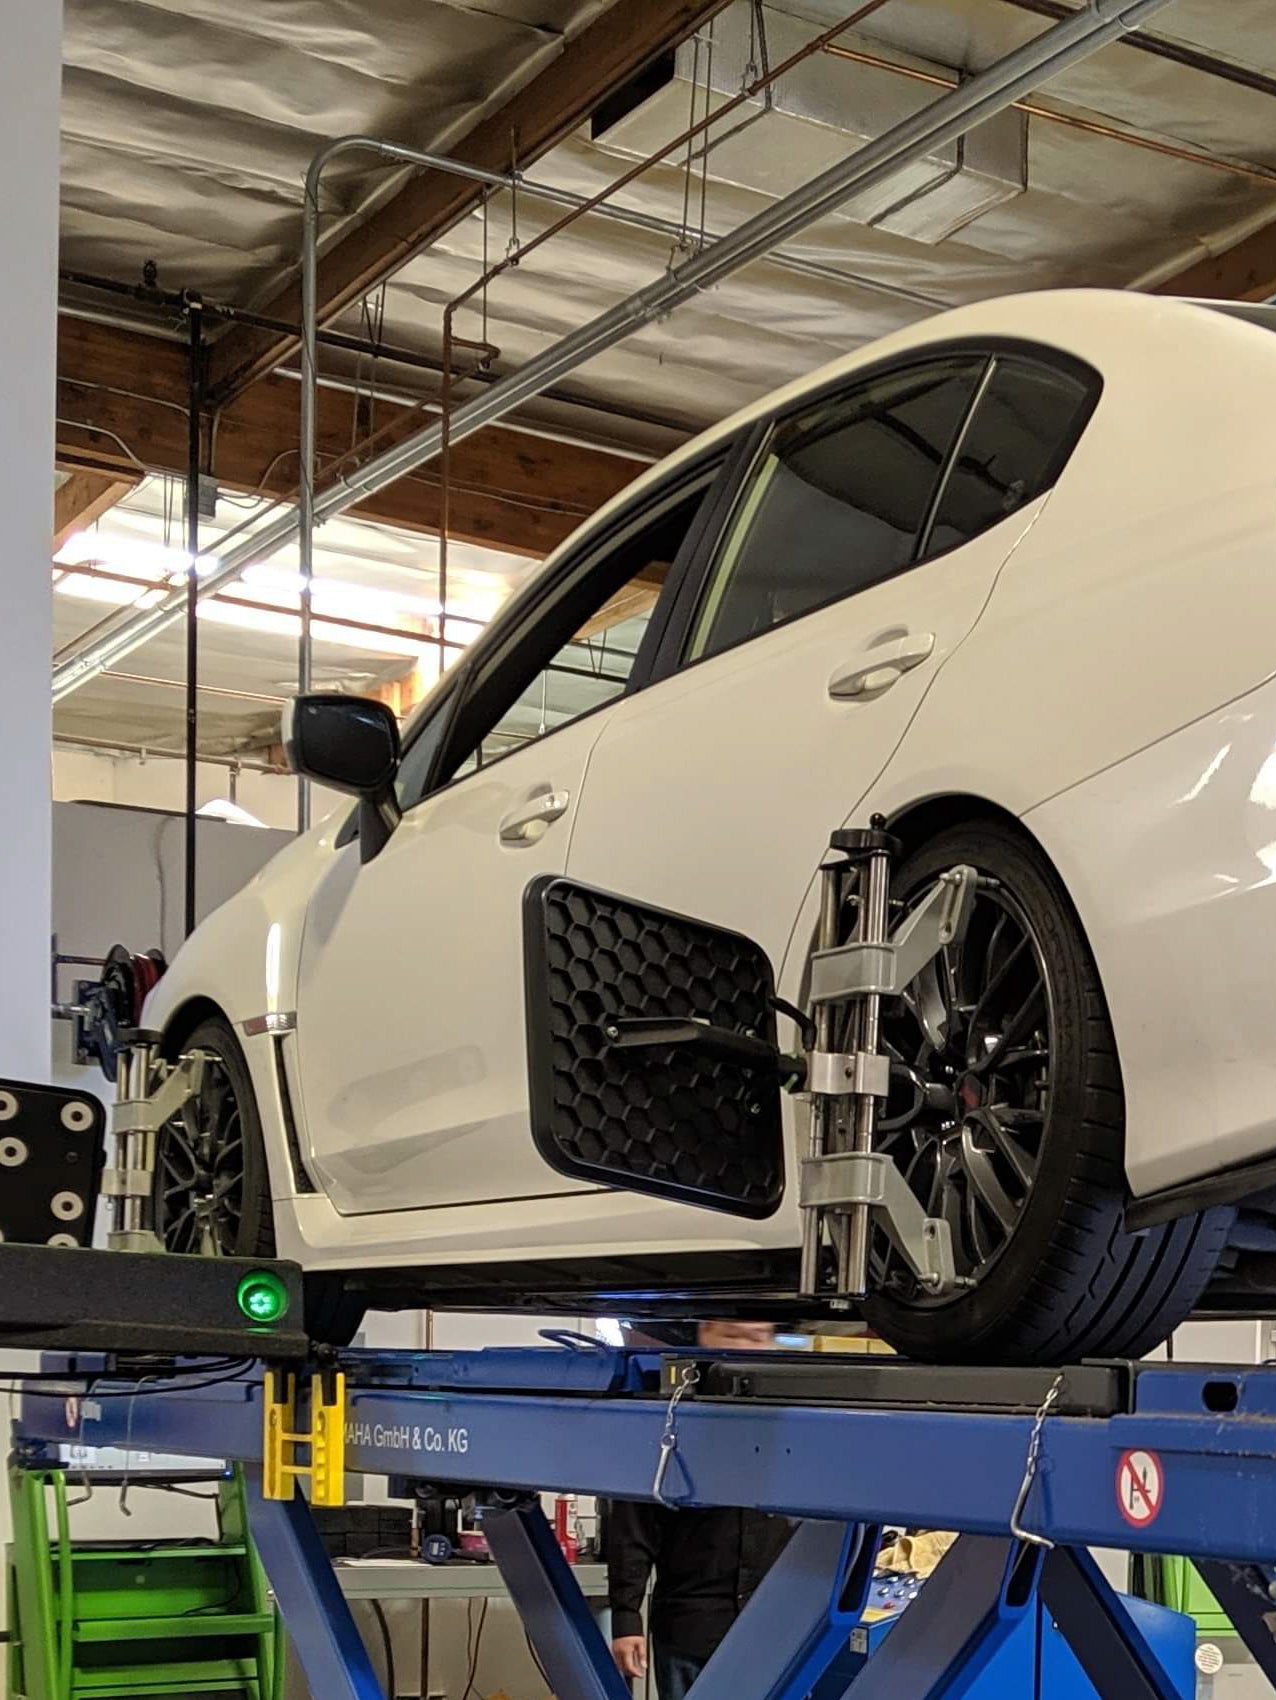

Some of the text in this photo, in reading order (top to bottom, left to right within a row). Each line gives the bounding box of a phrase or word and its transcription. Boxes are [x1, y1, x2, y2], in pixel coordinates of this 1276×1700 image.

[344, 1422, 469, 1453] AHA GmbH & Co. KG
